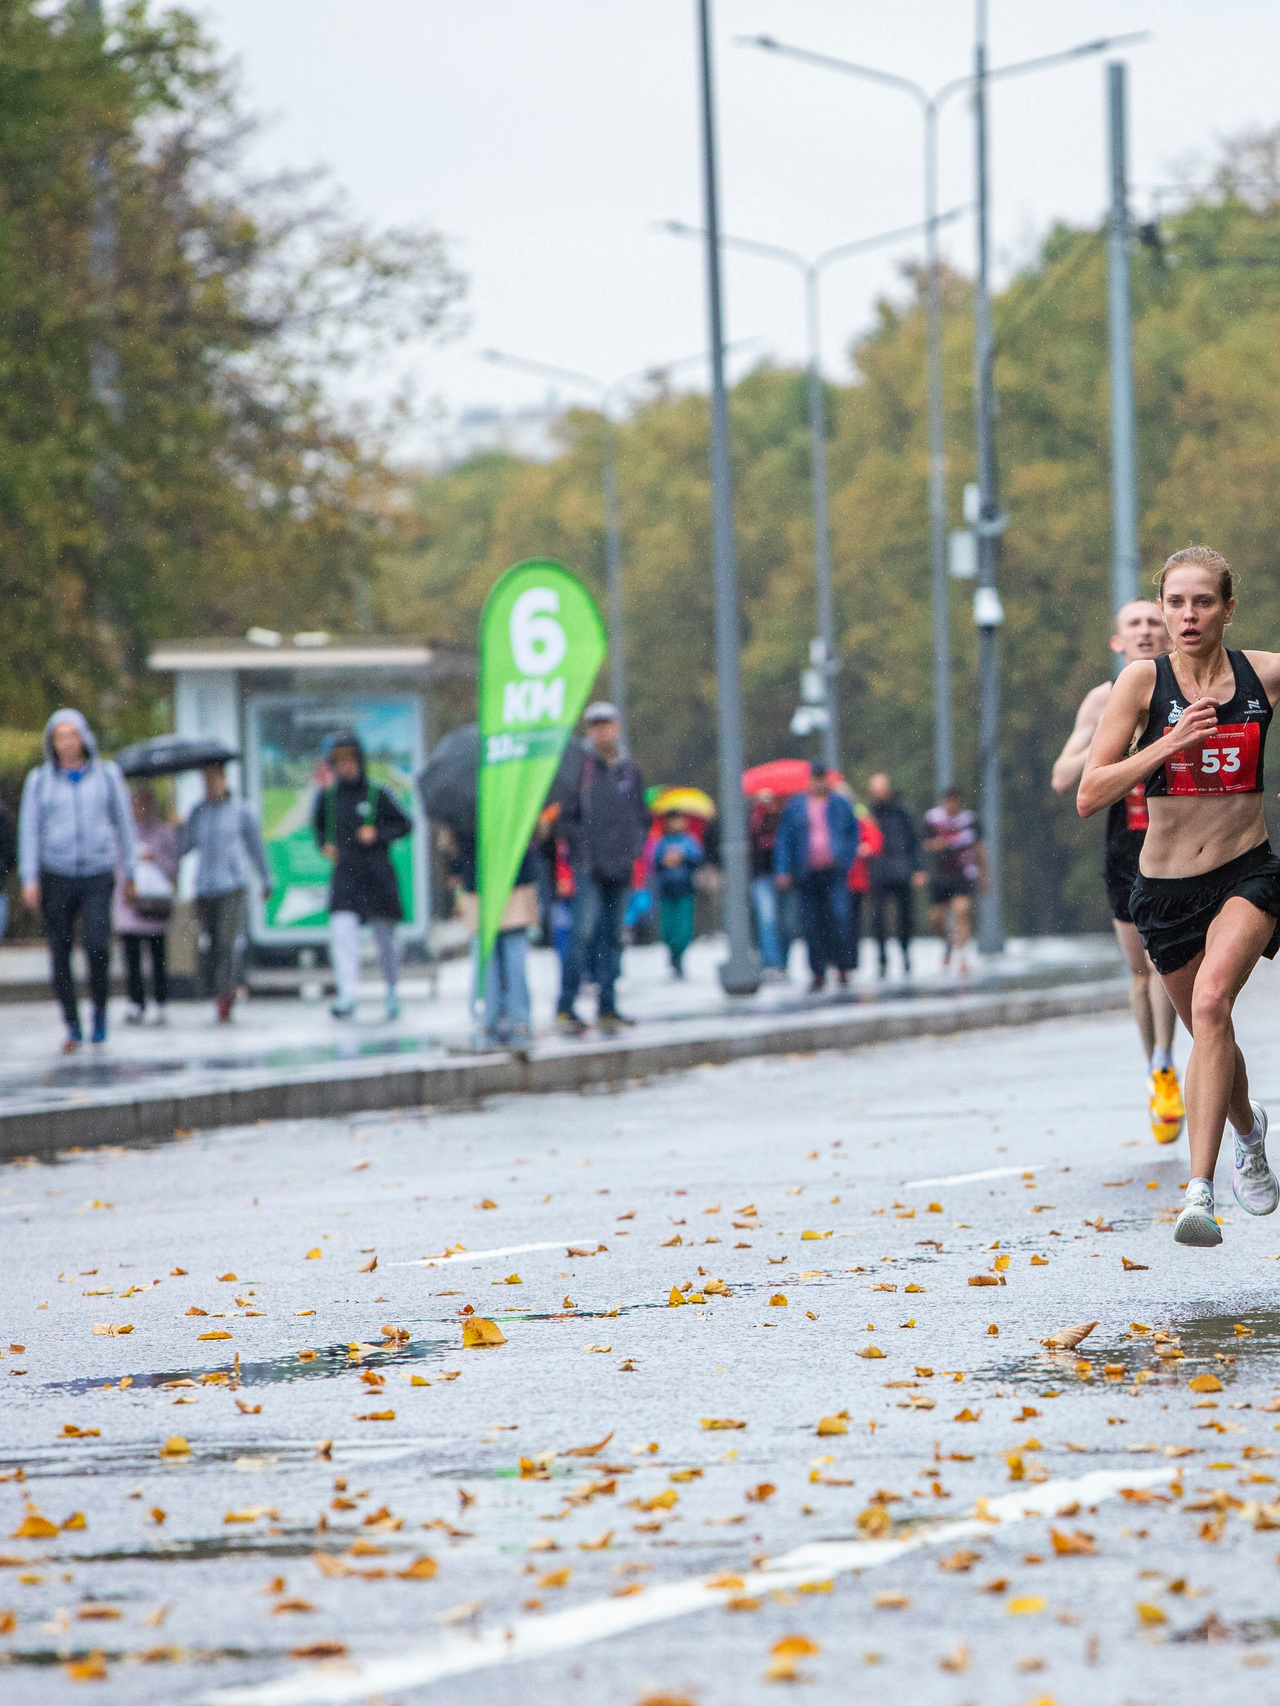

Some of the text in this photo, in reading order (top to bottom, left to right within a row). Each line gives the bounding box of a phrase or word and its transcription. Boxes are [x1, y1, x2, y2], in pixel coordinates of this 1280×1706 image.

[509, 586, 567, 676] 6
[503, 677, 567, 724] КМ
[1201, 747, 1241, 774] 53
